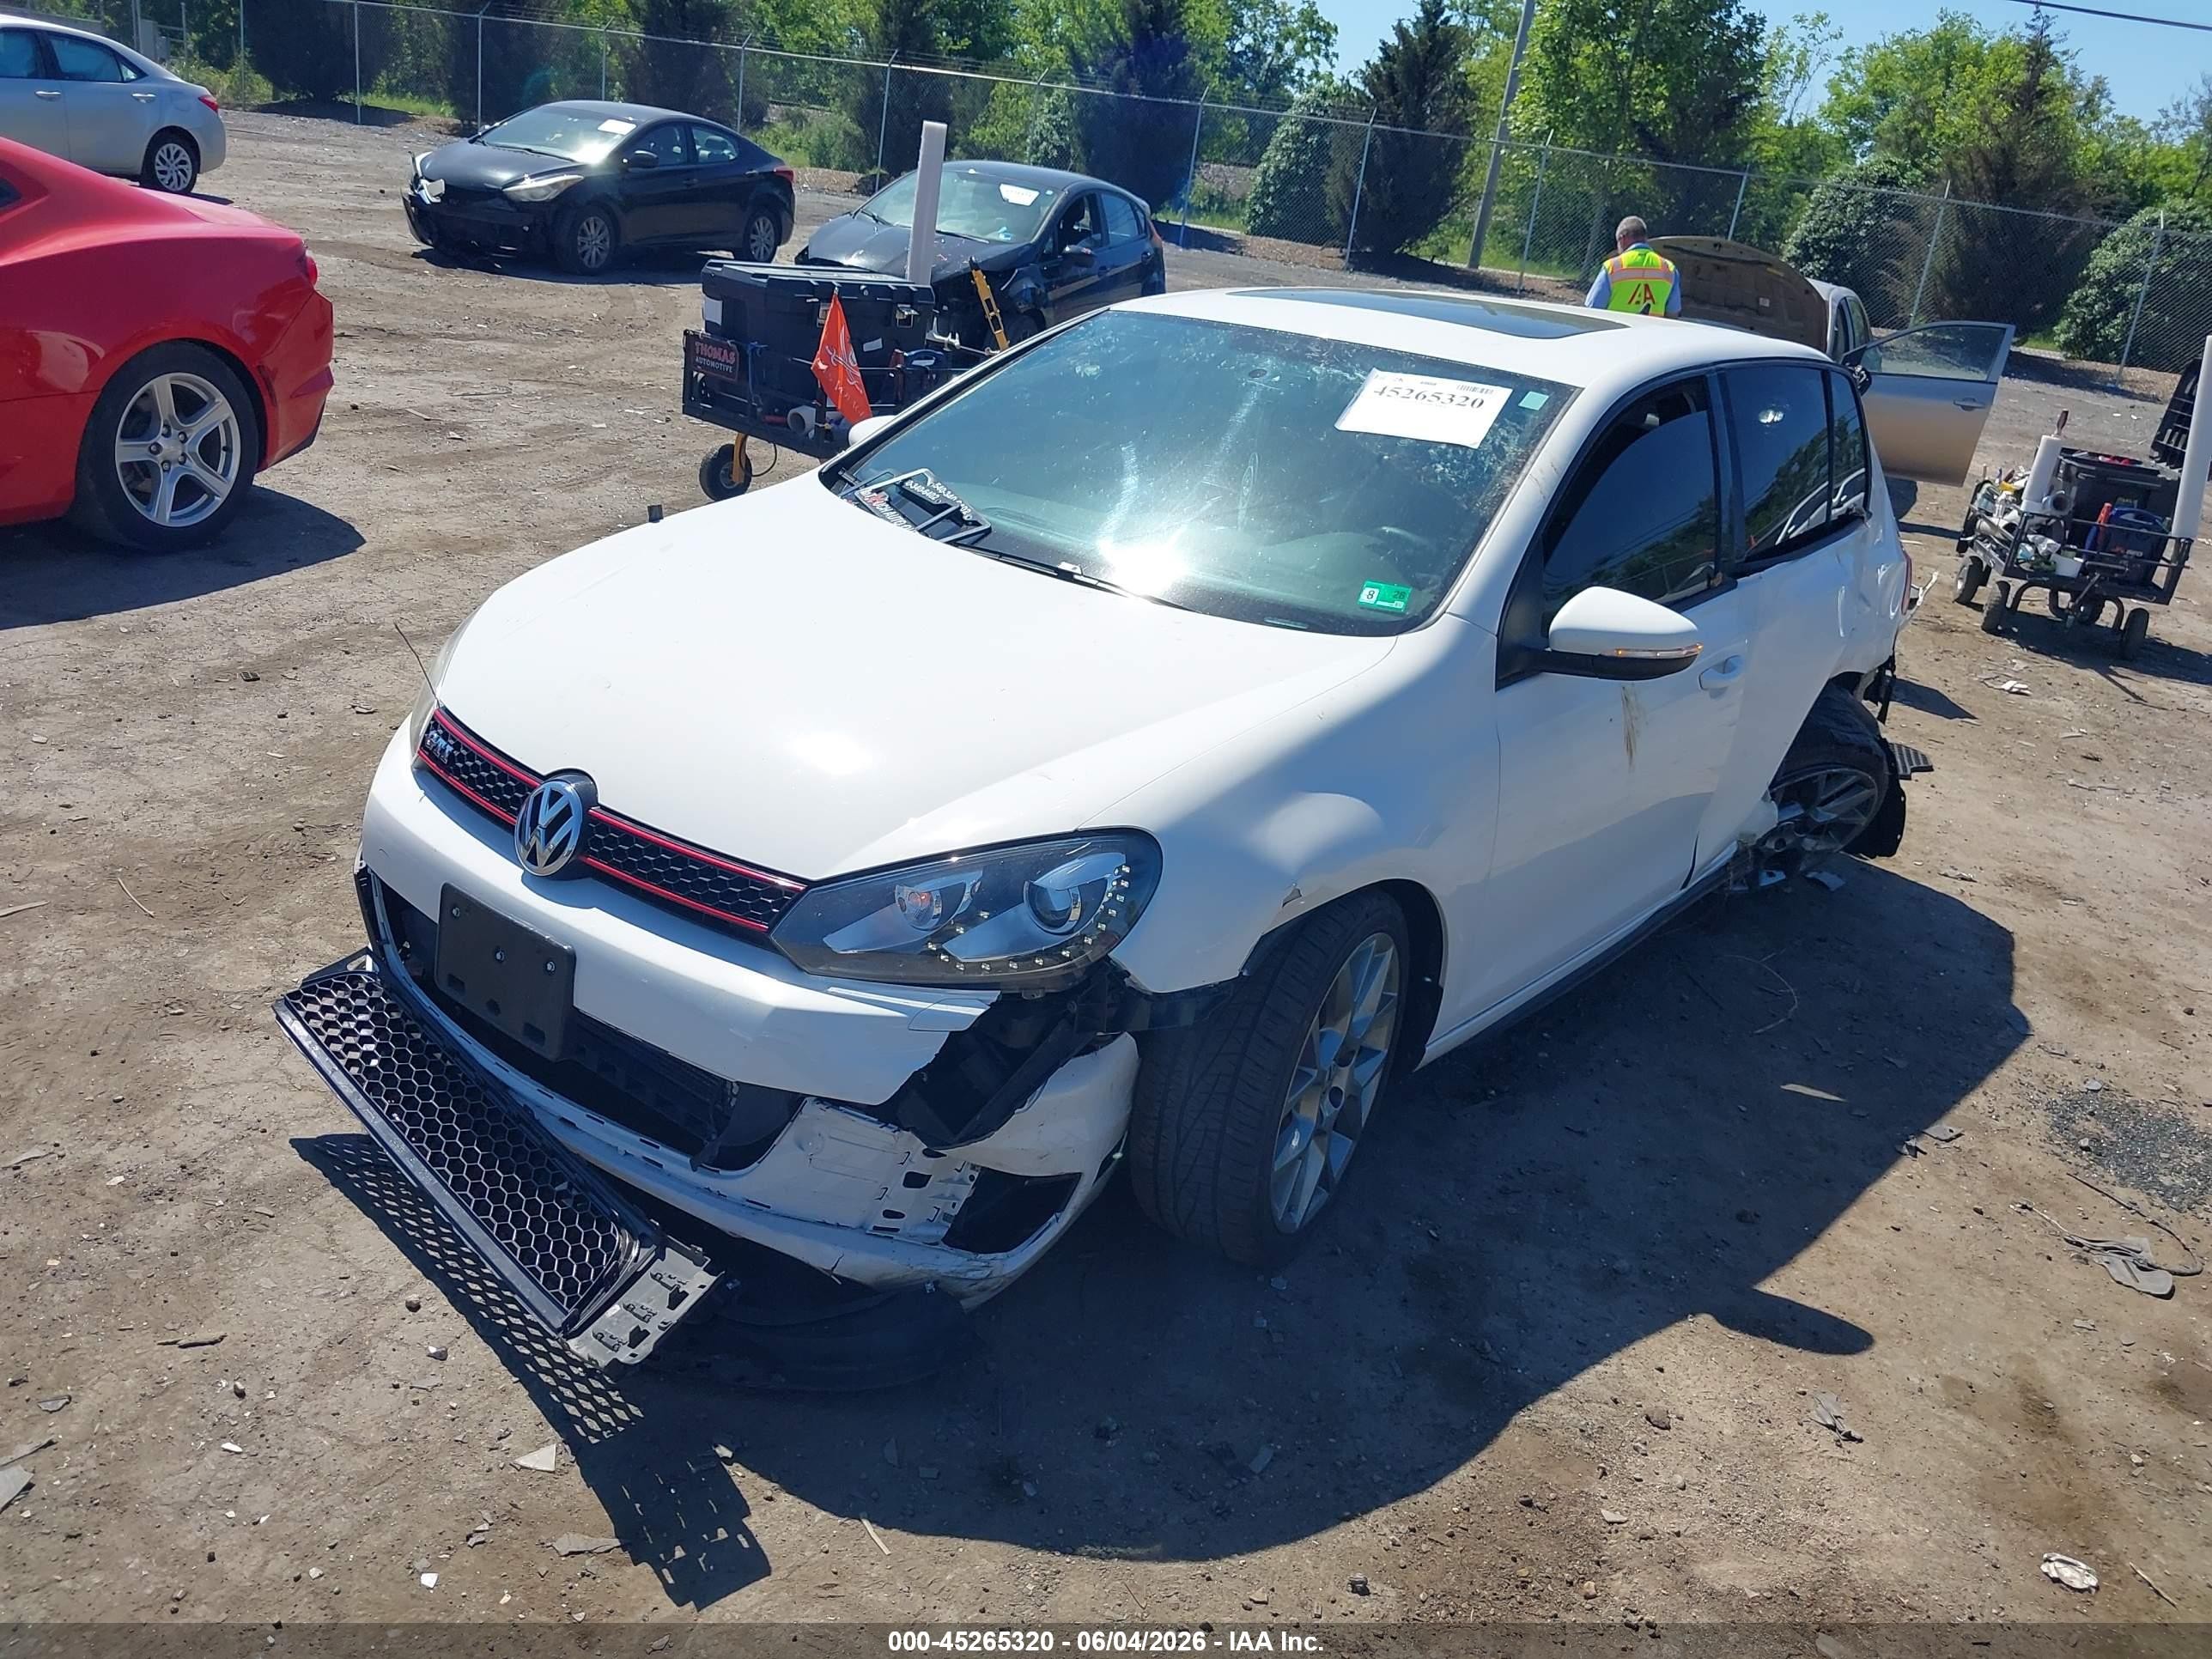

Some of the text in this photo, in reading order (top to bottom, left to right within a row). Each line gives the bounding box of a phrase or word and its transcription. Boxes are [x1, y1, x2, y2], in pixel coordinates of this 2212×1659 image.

[695, 342, 735, 365] THOMAS
[695, 356, 732, 373] AUTOMOTIVE
[1374, 386, 1484, 409] 45265320
[1366, 590, 1376, 600] 8
